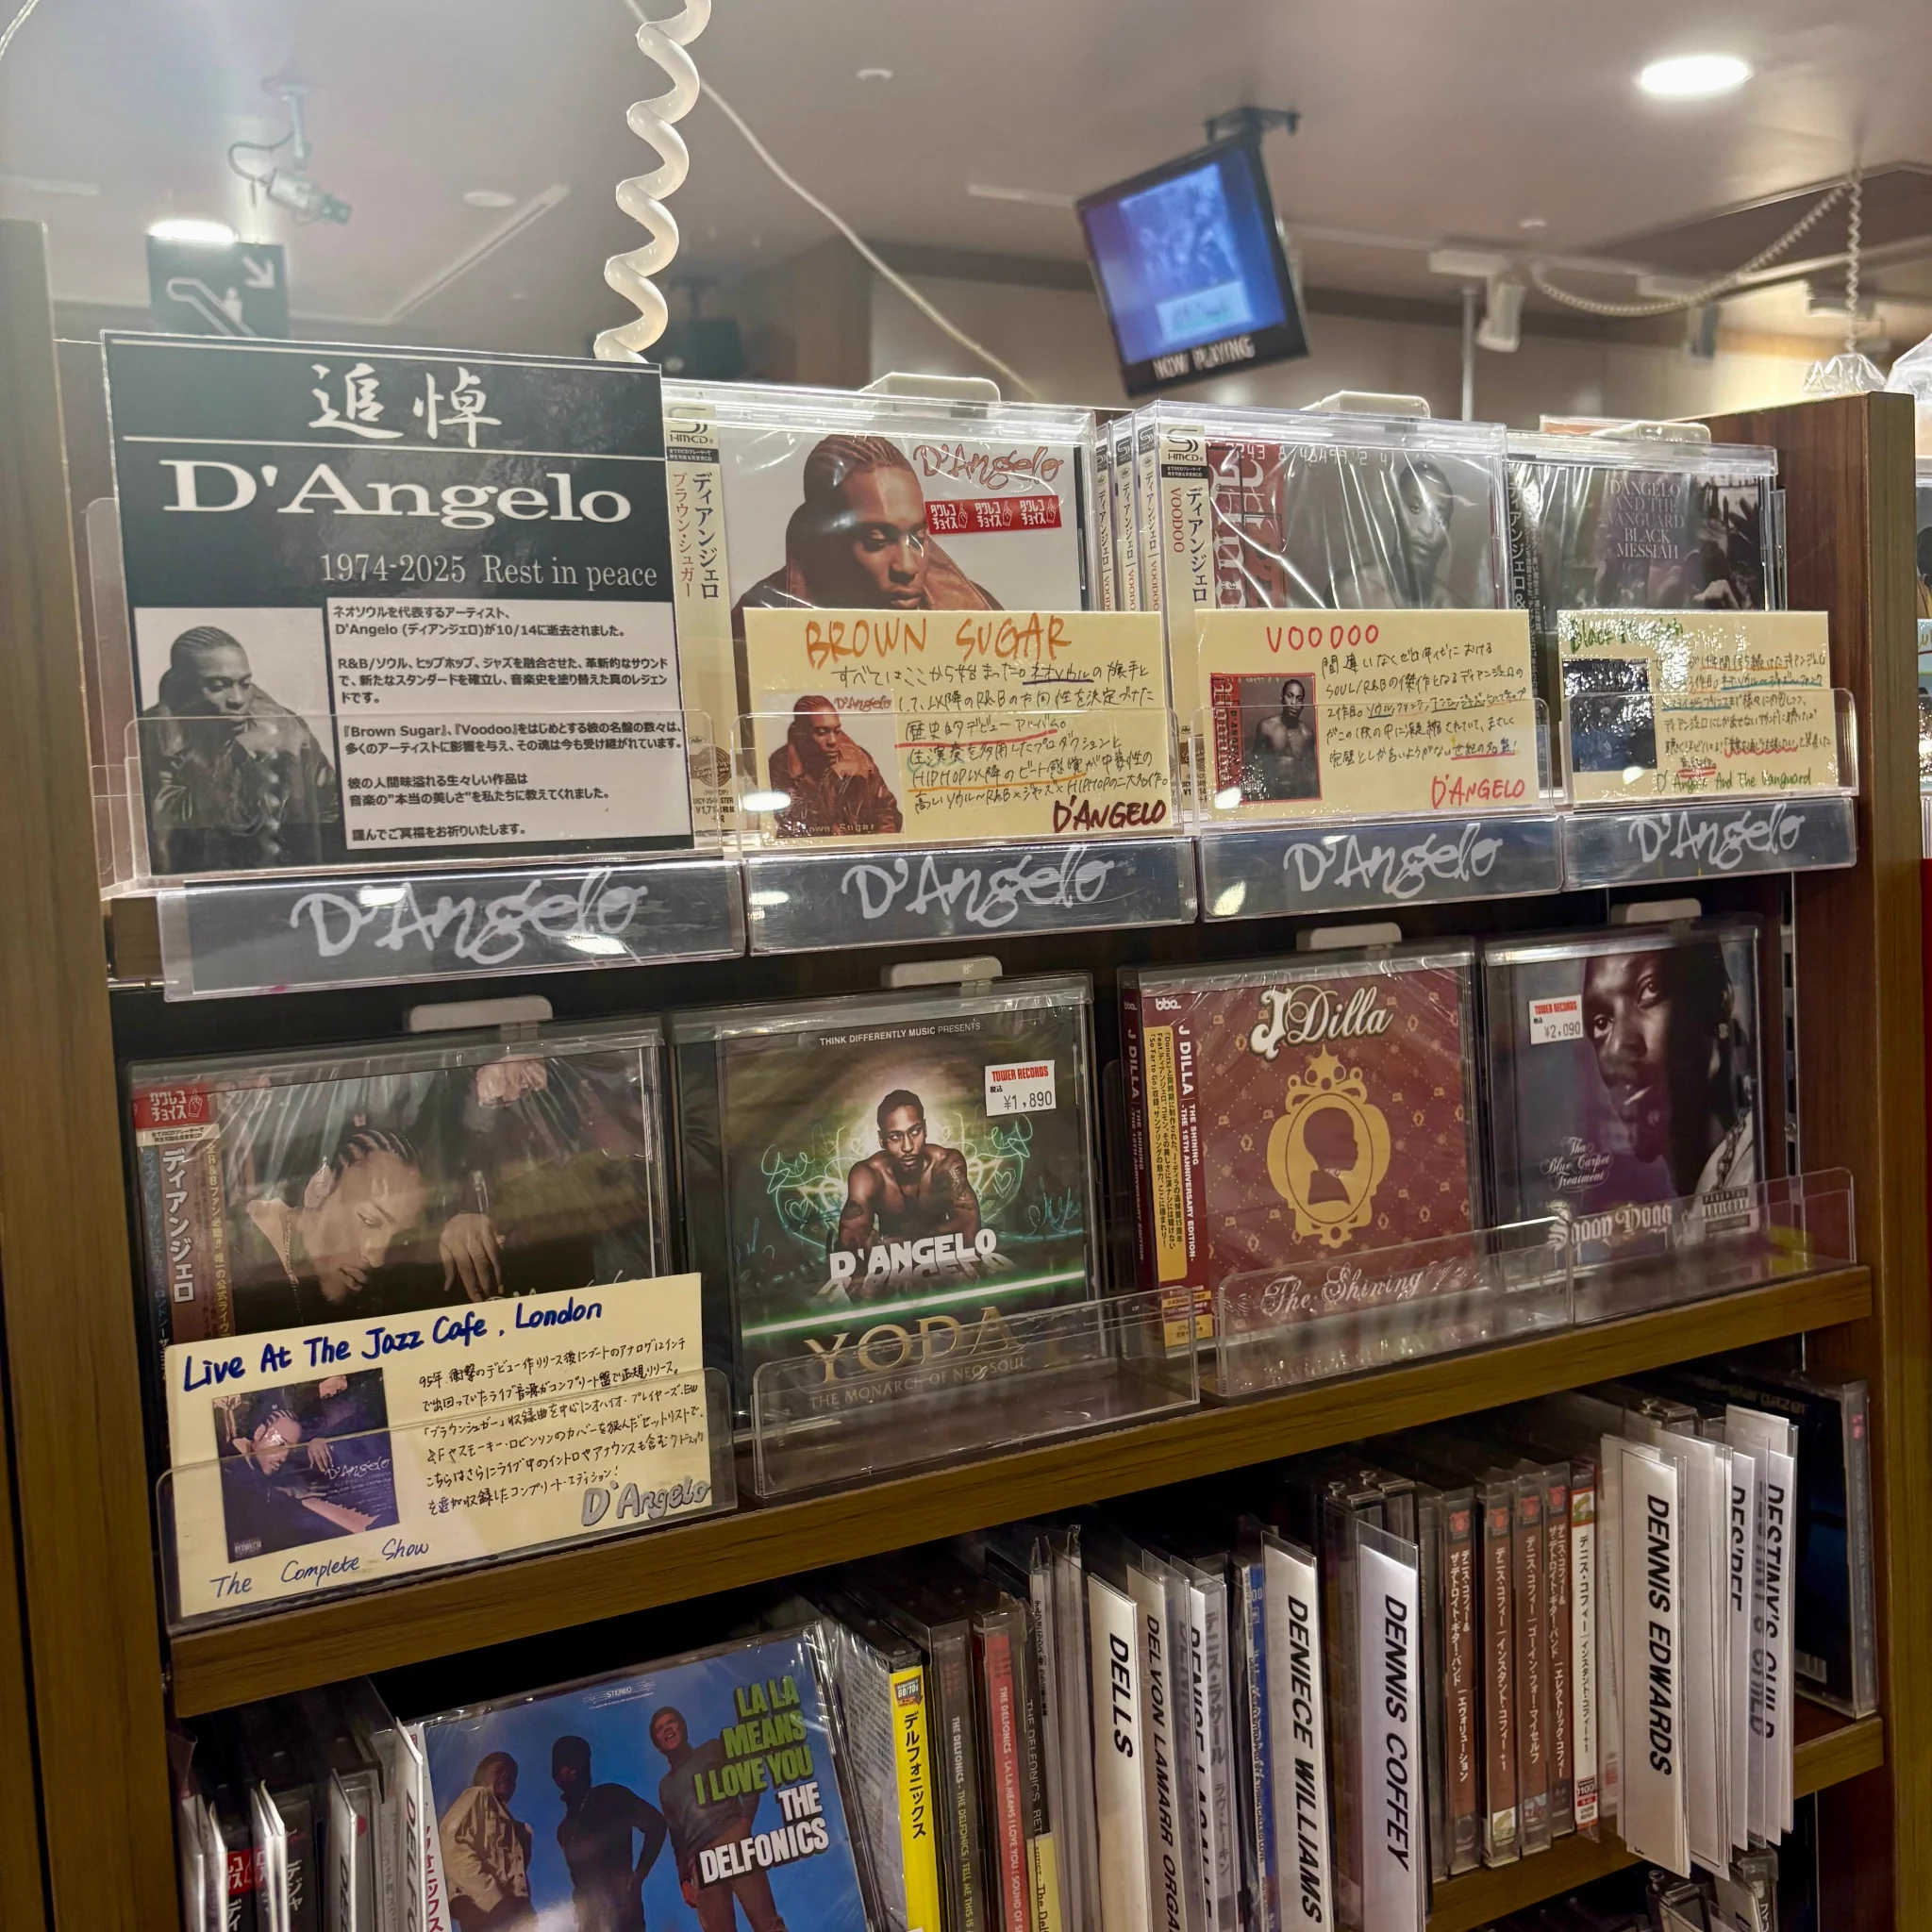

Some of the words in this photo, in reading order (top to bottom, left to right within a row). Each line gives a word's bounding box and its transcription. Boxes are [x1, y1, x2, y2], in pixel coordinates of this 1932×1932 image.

[1152, 352, 1190, 380] NOW
[1192, 334, 1256, 371] PLAYING
[308, 362, 503, 448] 追悼
[912, 442, 1064, 490] D'Angelo
[158, 458, 632, 530] D'Angelo
[930, 504, 957, 518] タワレコ
[974, 501, 1001, 515] タワレコ
[1019, 499, 1045, 513] タワレコ
[1145, 471, 1157, 550] ディアンジェロ
[673, 472, 696, 598] ブラウン・シュガー
[692, 472, 720, 600] ディアンジェロ
[932, 517, 958, 530] チョイス
[976, 515, 1003, 528] チョイス
[1021, 512, 1047, 526] チョイス
[1123, 482, 1134, 559] ディアンジェロ
[1171, 486, 1185, 553] VOODOO
[1624, 527, 1670, 544] BLACK
[1186, 487, 1208, 603] ディアンジェロ
[1617, 541, 1678, 559] MESSIAH
[320, 552, 467, 585] 1974-2025
[483, 559, 546, 586] Rest
[552, 559, 578, 586] in
[587, 564, 658, 591] peace
[333, 606, 510, 620] ネオソウルを代表するアーティスト、
[335, 624, 398, 636] D'Angelo
[805, 617, 927, 669] BROWN
[956, 612, 1073, 662] SUGAR
[1266, 623, 1379, 653] VOODOO
[341, 691, 380, 705] ドです。
[347, 774, 528, 790] 彼の人間味溢れる生々しい作品は
[1431, 774, 1525, 809] D'ANGELO
[352, 823, 526, 842] 謹んでご冥福をお祈りいたします。
[1053, 794, 1167, 834] D'ANGELO
[1626, 803, 1806, 870] D'Angelo
[1283, 823, 1504, 899] D'Angelo
[841, 846, 1115, 928] D'Angelo
[291, 865, 649, 965] D'Angelo
[1178, 1024, 1191, 1036] J
[1251, 987, 1293, 1061] J
[1285, 984, 1394, 1045] Dilla
[1534, 1003, 1553, 1015] TOWER
[1554, 1000, 1577, 1013] RECORDS
[820, 1035, 847, 1046] THINK
[849, 1029, 907, 1044] DIFFERENTLY
[908, 1025, 936, 1038] MUSIC
[991, 1069, 1017, 1082] TOWER
[1017, 1065, 1049, 1080] RECORDS
[1128, 1045, 1141, 1100] DILLA
[1179, 1041, 1194, 1096] DILLA
[149, 1090, 188, 1108] タワレコ
[151, 1105, 188, 1122] チョイス
[1190, 1125, 1199, 1166] SHINING
[1542, 1156, 1572, 1174] Blue
[1577, 1151, 1611, 1172] Carpet
[1183, 1156, 1194, 1218] ANNIVERSARY
[1556, 1172, 1606, 1189] Treatment
[162, 1147, 195, 1303] ディアンジェロ
[828, 1228, 997, 1280] D'ANGELO
[1261, 1274, 1312, 1317] The
[1320, 1260, 1424, 1308] Shining
[183, 1353, 245, 1393] Live
[260, 1341, 292, 1372] At
[303, 1332, 352, 1366] The
[358, 1326, 424, 1366] Jazz
[515, 1298, 604, 1330] London
[804, 1306, 1024, 1384] YODA
[809, 1394, 840, 1410] THE
[845, 1377, 926, 1404] MONARCH
[928, 1371, 947, 1386] OF
[580, 1474, 712, 1528] D'Angelo
[210, 1571, 253, 1599] The
[281, 1554, 360, 1588] Complete
[382, 1538, 430, 1563] Show
[1525, 1535, 1537, 1615] デニス・コフィー
[1646, 1493, 1671, 1614] DENNIS
[1494, 1547, 1507, 1627] デニス・コフィー
[1579, 1535, 1590, 1633] デニス・コフィー
[1146, 1613, 1166, 1729] DELVON
[1288, 1594, 1314, 1750] DENIECE
[1384, 1592, 1407, 1724] DENNIS
[606, 1686, 632, 1698] STEREO
[736, 1681, 769, 1719] LA
[769, 1674, 801, 1707] LA
[999, 1686, 1008, 1707] THE
[1108, 1631, 1134, 1759] DELLS
[1648, 1620, 1673, 1777] EDWARDS
[722, 1710, 808, 1760] MEANS
[952, 1716, 961, 1734] THE
[1000, 1707, 1012, 1755] DELFONICS
[693, 1772, 708, 1806] I
[710, 1756, 769, 1802] LOVE
[764, 1743, 815, 1785] YOU
[903, 1712, 928, 1839] デルフォニックス
[953, 1735, 964, 1785] DELFONICS
[1004, 1760, 1012, 1774] LA
[1005, 1774, 1013, 1787] LA
[778, 1781, 824, 1823] THE
[1006, 1788, 1015, 1818] MEANS
[1153, 1734, 1174, 1848] LAMARR
[1385, 1732, 1411, 1873] COFFEY
[699, 1818, 830, 1885] DELFONICS
[958, 1810, 970, 1854] DELFONICS
[1008, 1824, 1017, 1844] LOVE
[1293, 1757, 1323, 1924] WILLIAMS
[962, 1860, 971, 1880] TELL
[1009, 1844, 1019, 1868] YOU
[963, 1880, 972, 1894] ME
[965, 1894, 974, 1917] THIS
[1012, 1874, 1022, 1906] SOUND
[967, 1917, 974, 1928] IS
[1015, 1907, 1024, 1924] OF
